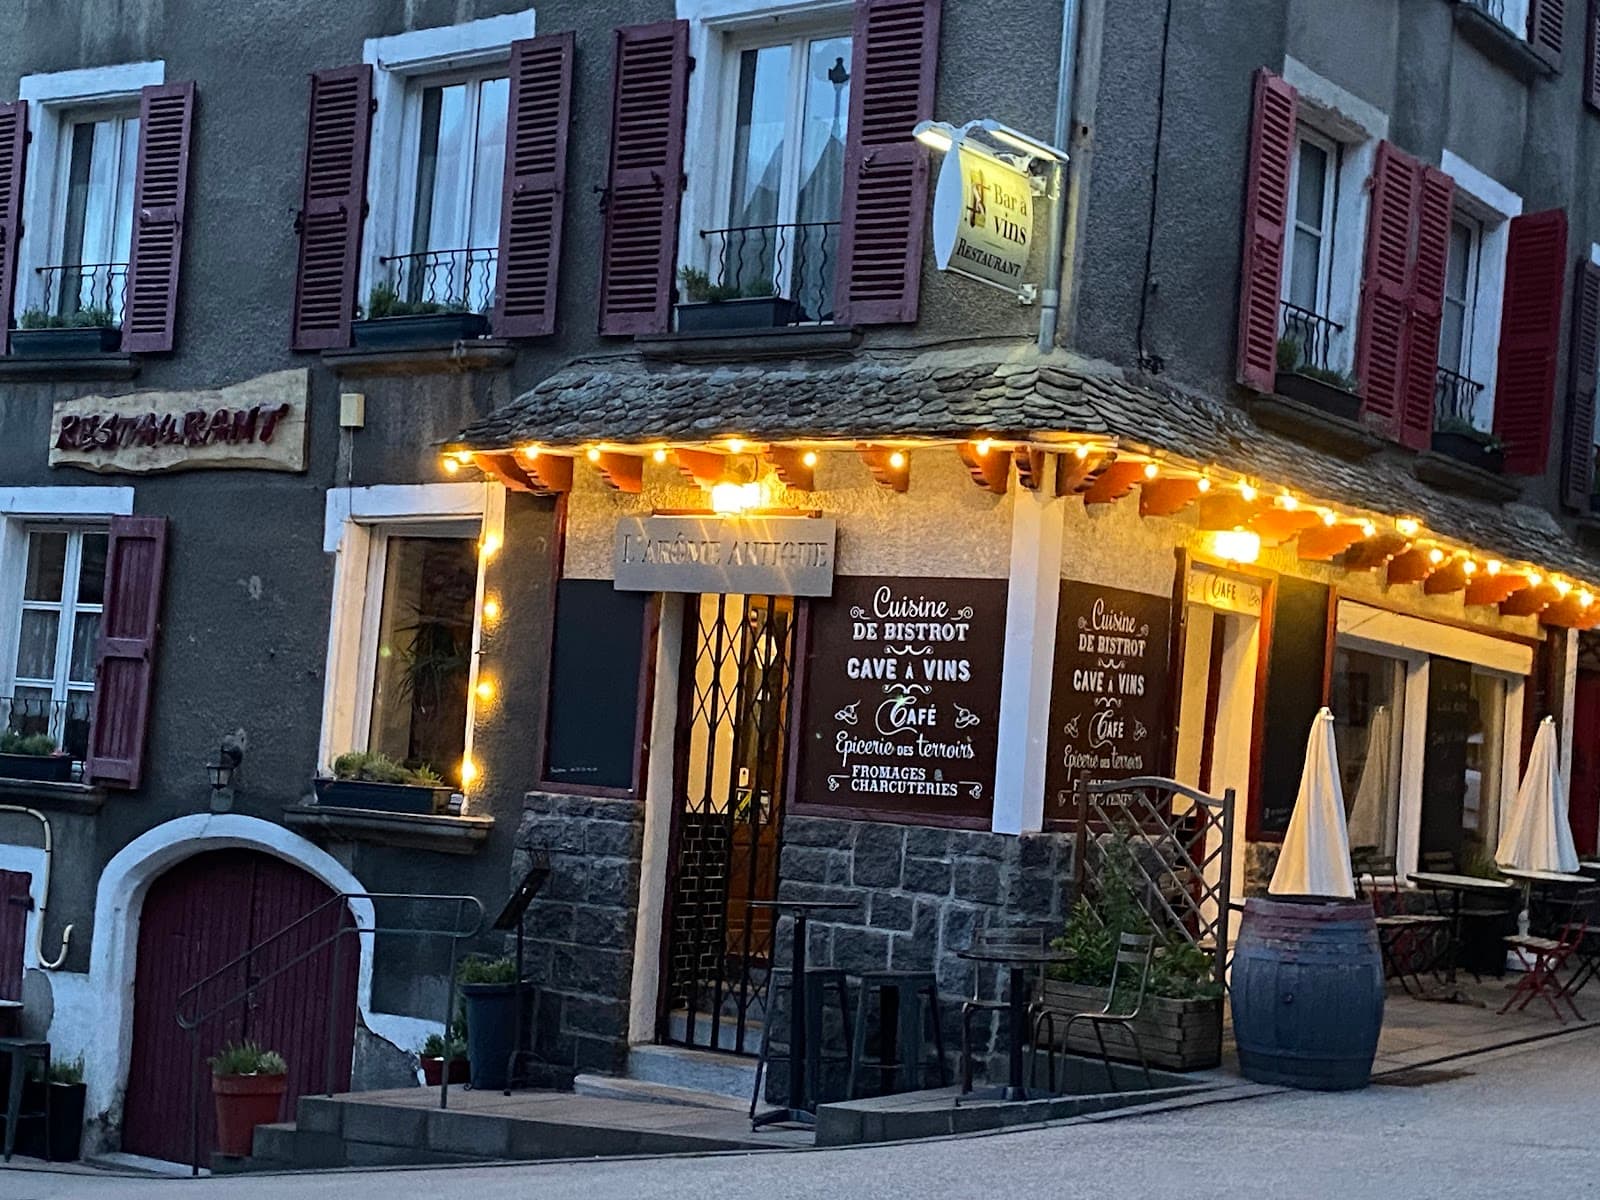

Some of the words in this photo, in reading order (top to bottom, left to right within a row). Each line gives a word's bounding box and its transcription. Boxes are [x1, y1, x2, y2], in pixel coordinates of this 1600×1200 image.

[994, 183, 1018, 211] Bar
[1020, 195, 1027, 217] à
[994, 213, 1027, 246] vins
[956, 237, 1022, 277] RESTAURANT
[55, 403, 290, 451] RESTAURANT
[727, 541, 828, 567] ANTIQUE
[873, 585, 949, 619] Cuisine
[1092, 598, 1137, 634] Cuisine
[852, 622, 878, 641] DE
[884, 622, 970, 642] BISTROT
[1078, 633, 1096, 653] DE
[1097, 635, 1147, 658] BISTROT
[847, 657, 898, 680] CAVE
[923, 659, 971, 683] VINS
[1073, 669, 1105, 693] CAVE
[1118, 672, 1146, 696] VINS
[835, 730, 895, 768] Epicerie
[896, 745, 914, 757] DES
[916, 733, 975, 760] terroirs
[852, 764, 926, 780] FROMAGES
[851, 778, 959, 797] CHARCUTERIES
